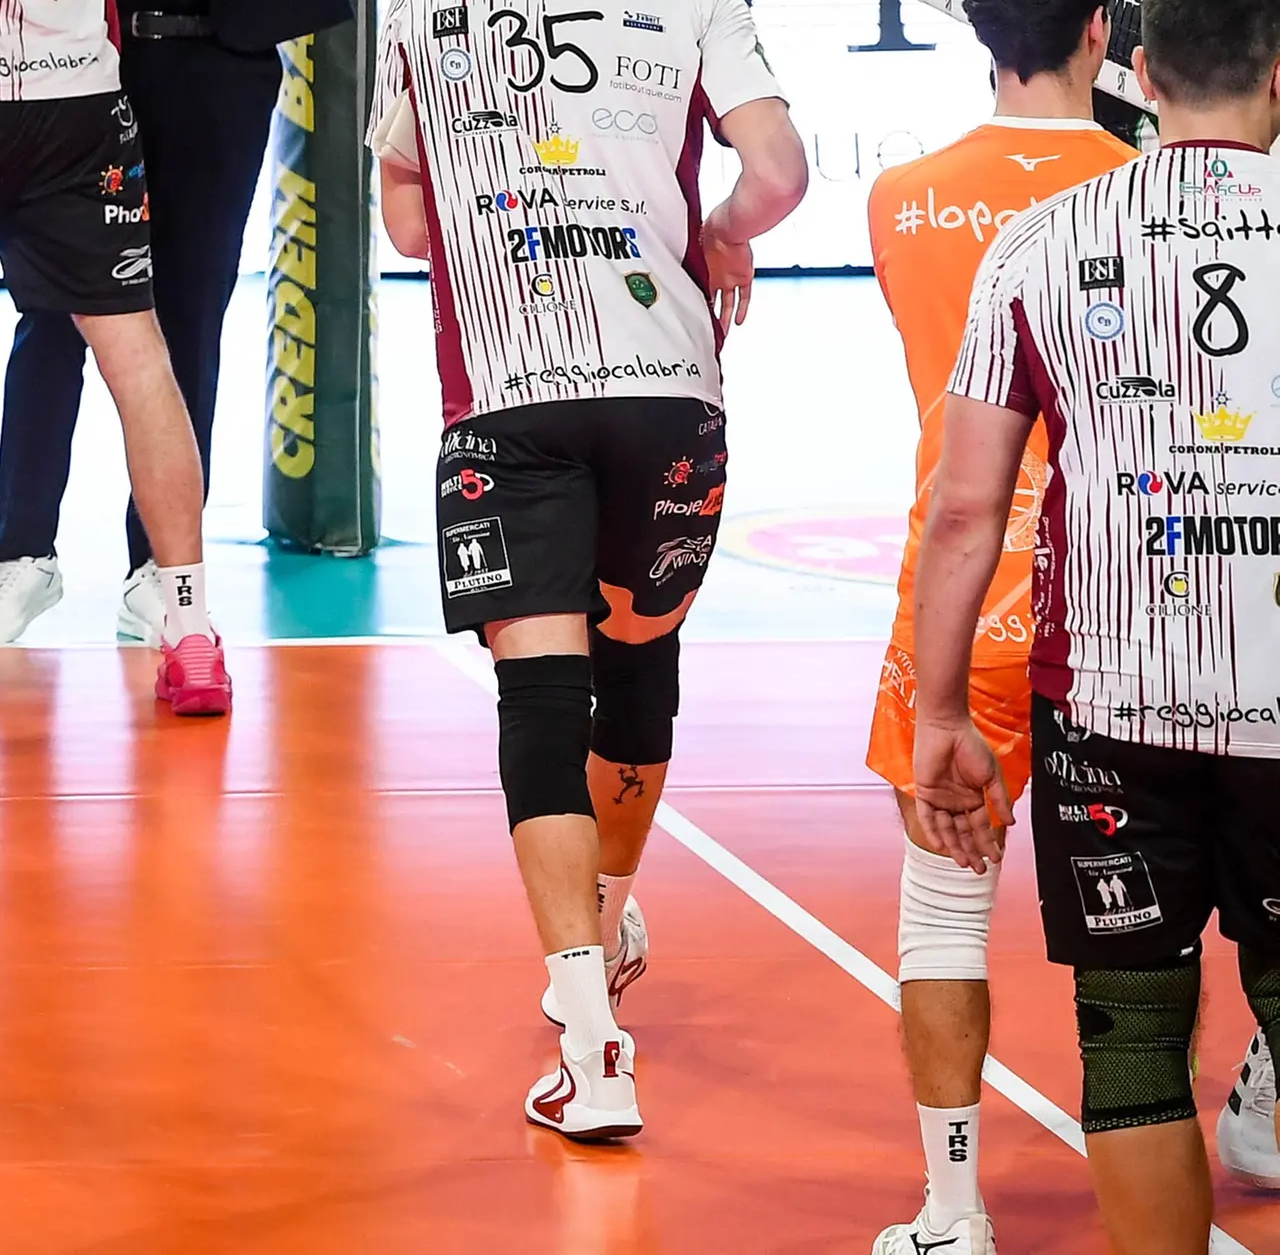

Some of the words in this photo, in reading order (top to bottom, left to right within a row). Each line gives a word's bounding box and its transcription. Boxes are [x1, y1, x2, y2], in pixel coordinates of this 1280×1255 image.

[488, 9, 604, 93] 35
[614, 55, 683, 90] FOTI
[591, 107, 658, 135] eco
[1083, 258, 1120, 283] B&F
[270, 170, 316, 480] CREDEM
[1192, 262, 1249, 357] 8
[504, 355, 701, 392] #reggiocalabria
[1168, 446, 1221, 455] CORONA
[1116, 470, 1209, 496] ROVA
[174, 574, 194, 608] TRS
[454, 573, 503, 589] PLUTINO
[1145, 604, 1211, 617] CILIONE
[1094, 910, 1151, 927] PLUTINO
[948, 1119, 970, 1163] TRS
